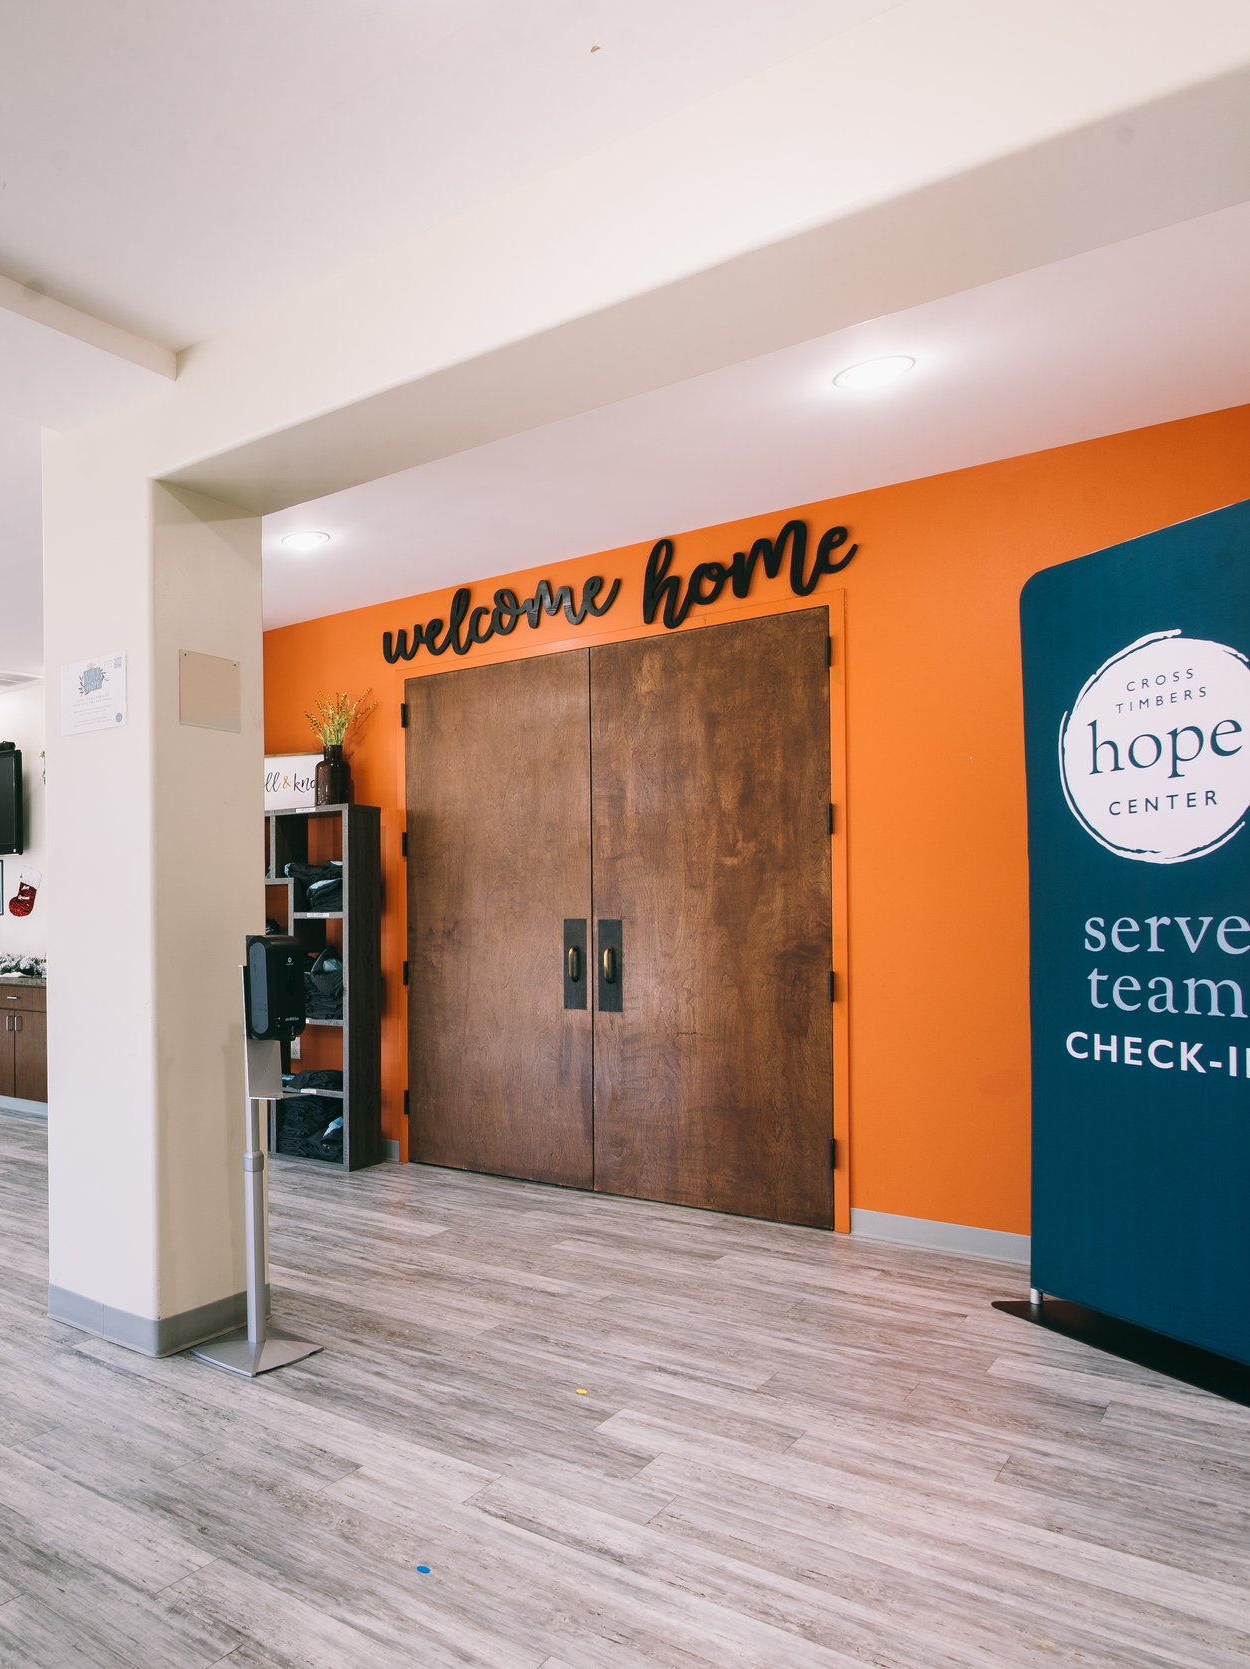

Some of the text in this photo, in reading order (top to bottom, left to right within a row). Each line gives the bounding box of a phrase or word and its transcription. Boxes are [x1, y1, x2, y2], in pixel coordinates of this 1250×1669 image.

[383, 520, 858, 664] welcome home
[1126, 668, 1194, 692] CROSS
[1116, 687, 1207, 714] TIMBERS
[1087, 719, 1243, 779] hope
[264, 771, 316, 793] ll & kno
[1108, 790, 1218, 816] CENTER
[1085, 915, 1250, 955] serve
[1087, 968, 1249, 1018] team
[1066, 1031, 1250, 1079] CHECK-I
